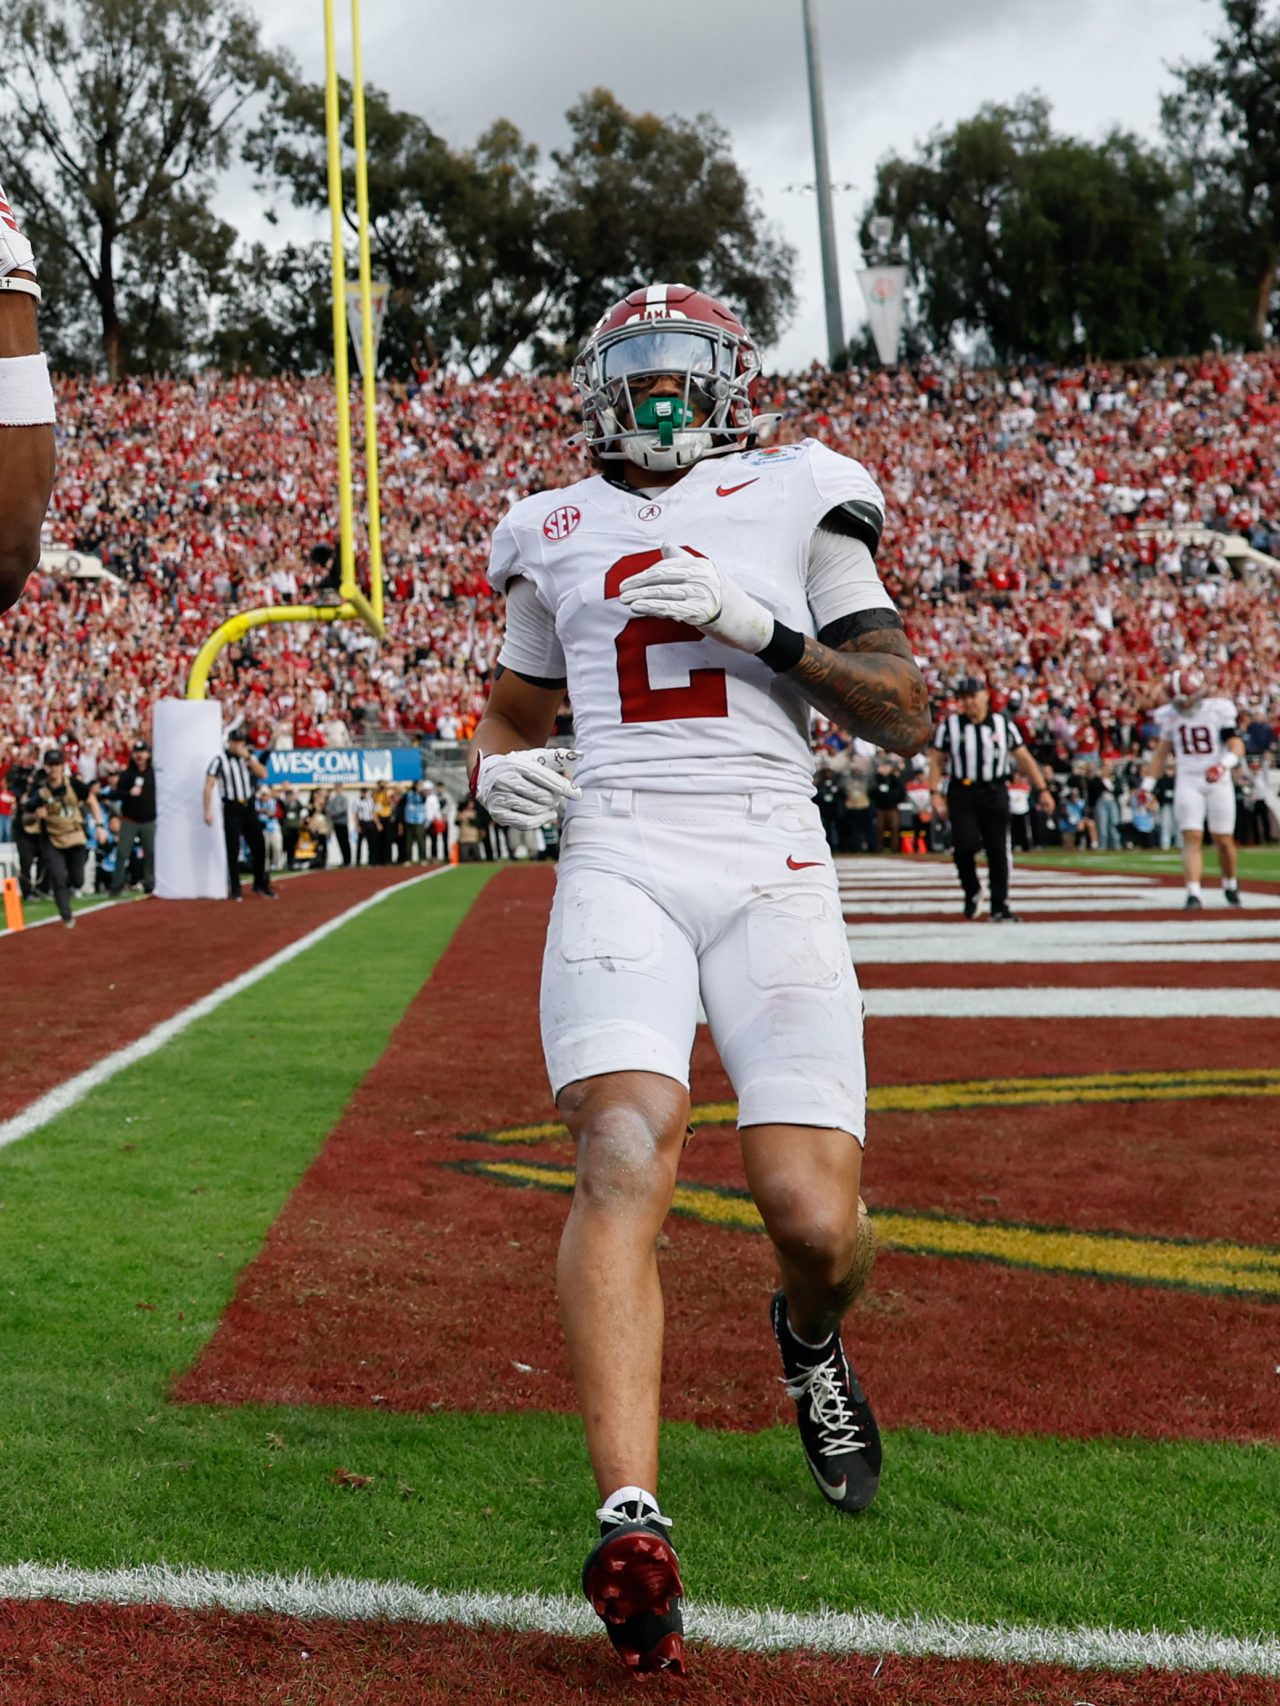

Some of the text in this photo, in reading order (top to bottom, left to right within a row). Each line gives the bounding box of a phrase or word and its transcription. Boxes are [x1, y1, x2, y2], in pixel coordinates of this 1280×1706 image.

[543, 506, 582, 541] SEC
[604, 545, 729, 724] 2
[1179, 725, 1213, 754] 18
[270, 751, 359, 774] WESCOM
